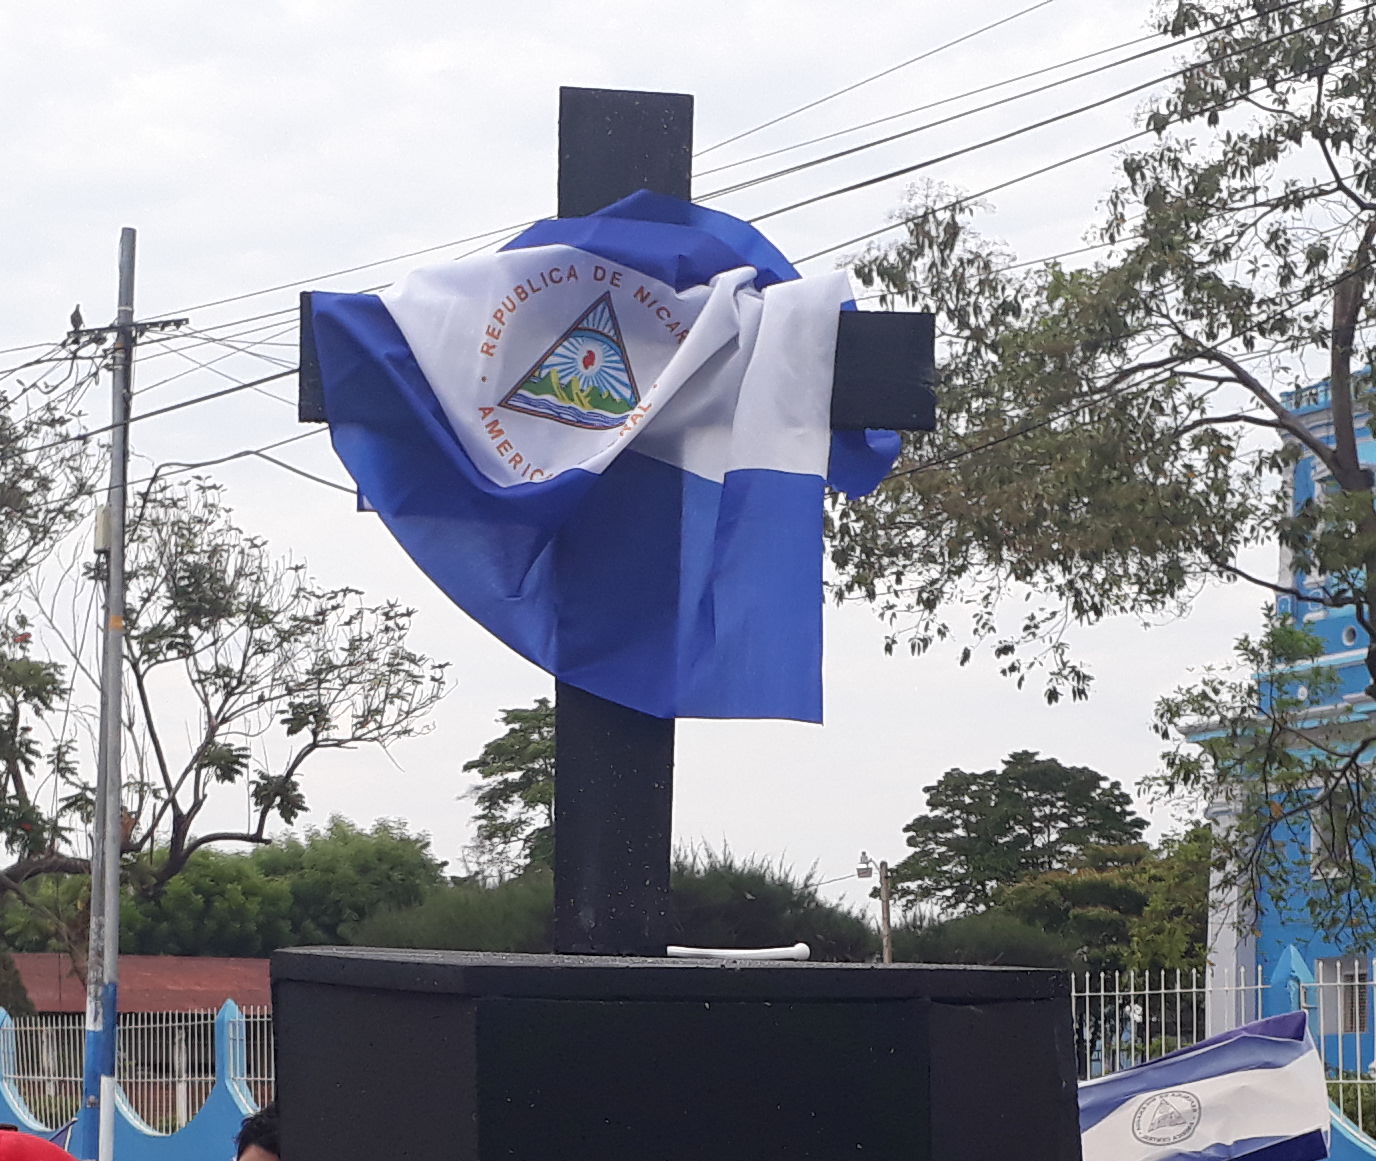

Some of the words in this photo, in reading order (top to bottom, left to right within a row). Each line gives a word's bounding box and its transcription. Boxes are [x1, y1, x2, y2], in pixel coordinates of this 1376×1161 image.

[481, 264, 578, 357] REPUBLICA
[593, 266, 623, 288] DE
[632, 286, 690, 345] NICAR
[478, 407, 554, 481] AMERIC
